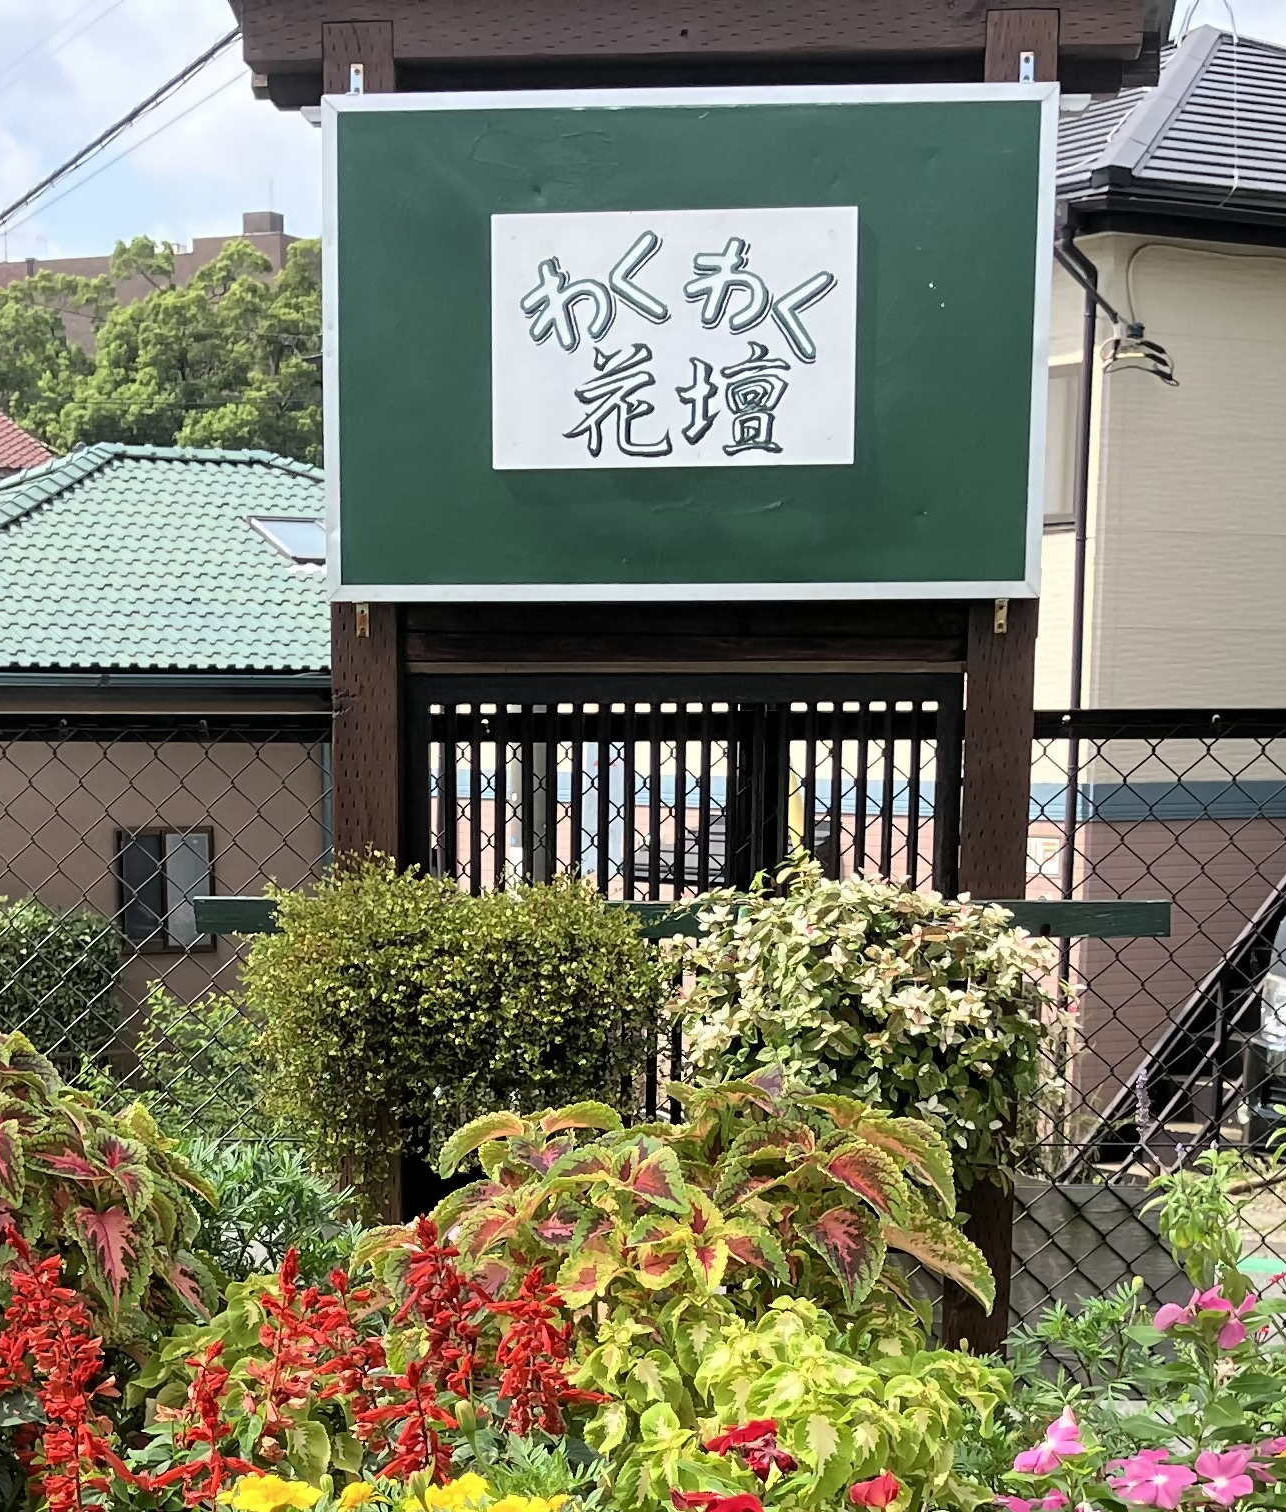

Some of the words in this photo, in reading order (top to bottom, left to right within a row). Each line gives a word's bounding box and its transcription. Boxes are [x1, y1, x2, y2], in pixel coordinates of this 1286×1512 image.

[520, 230, 837, 364] わくわく
[562, 341, 792, 458] 花壇
